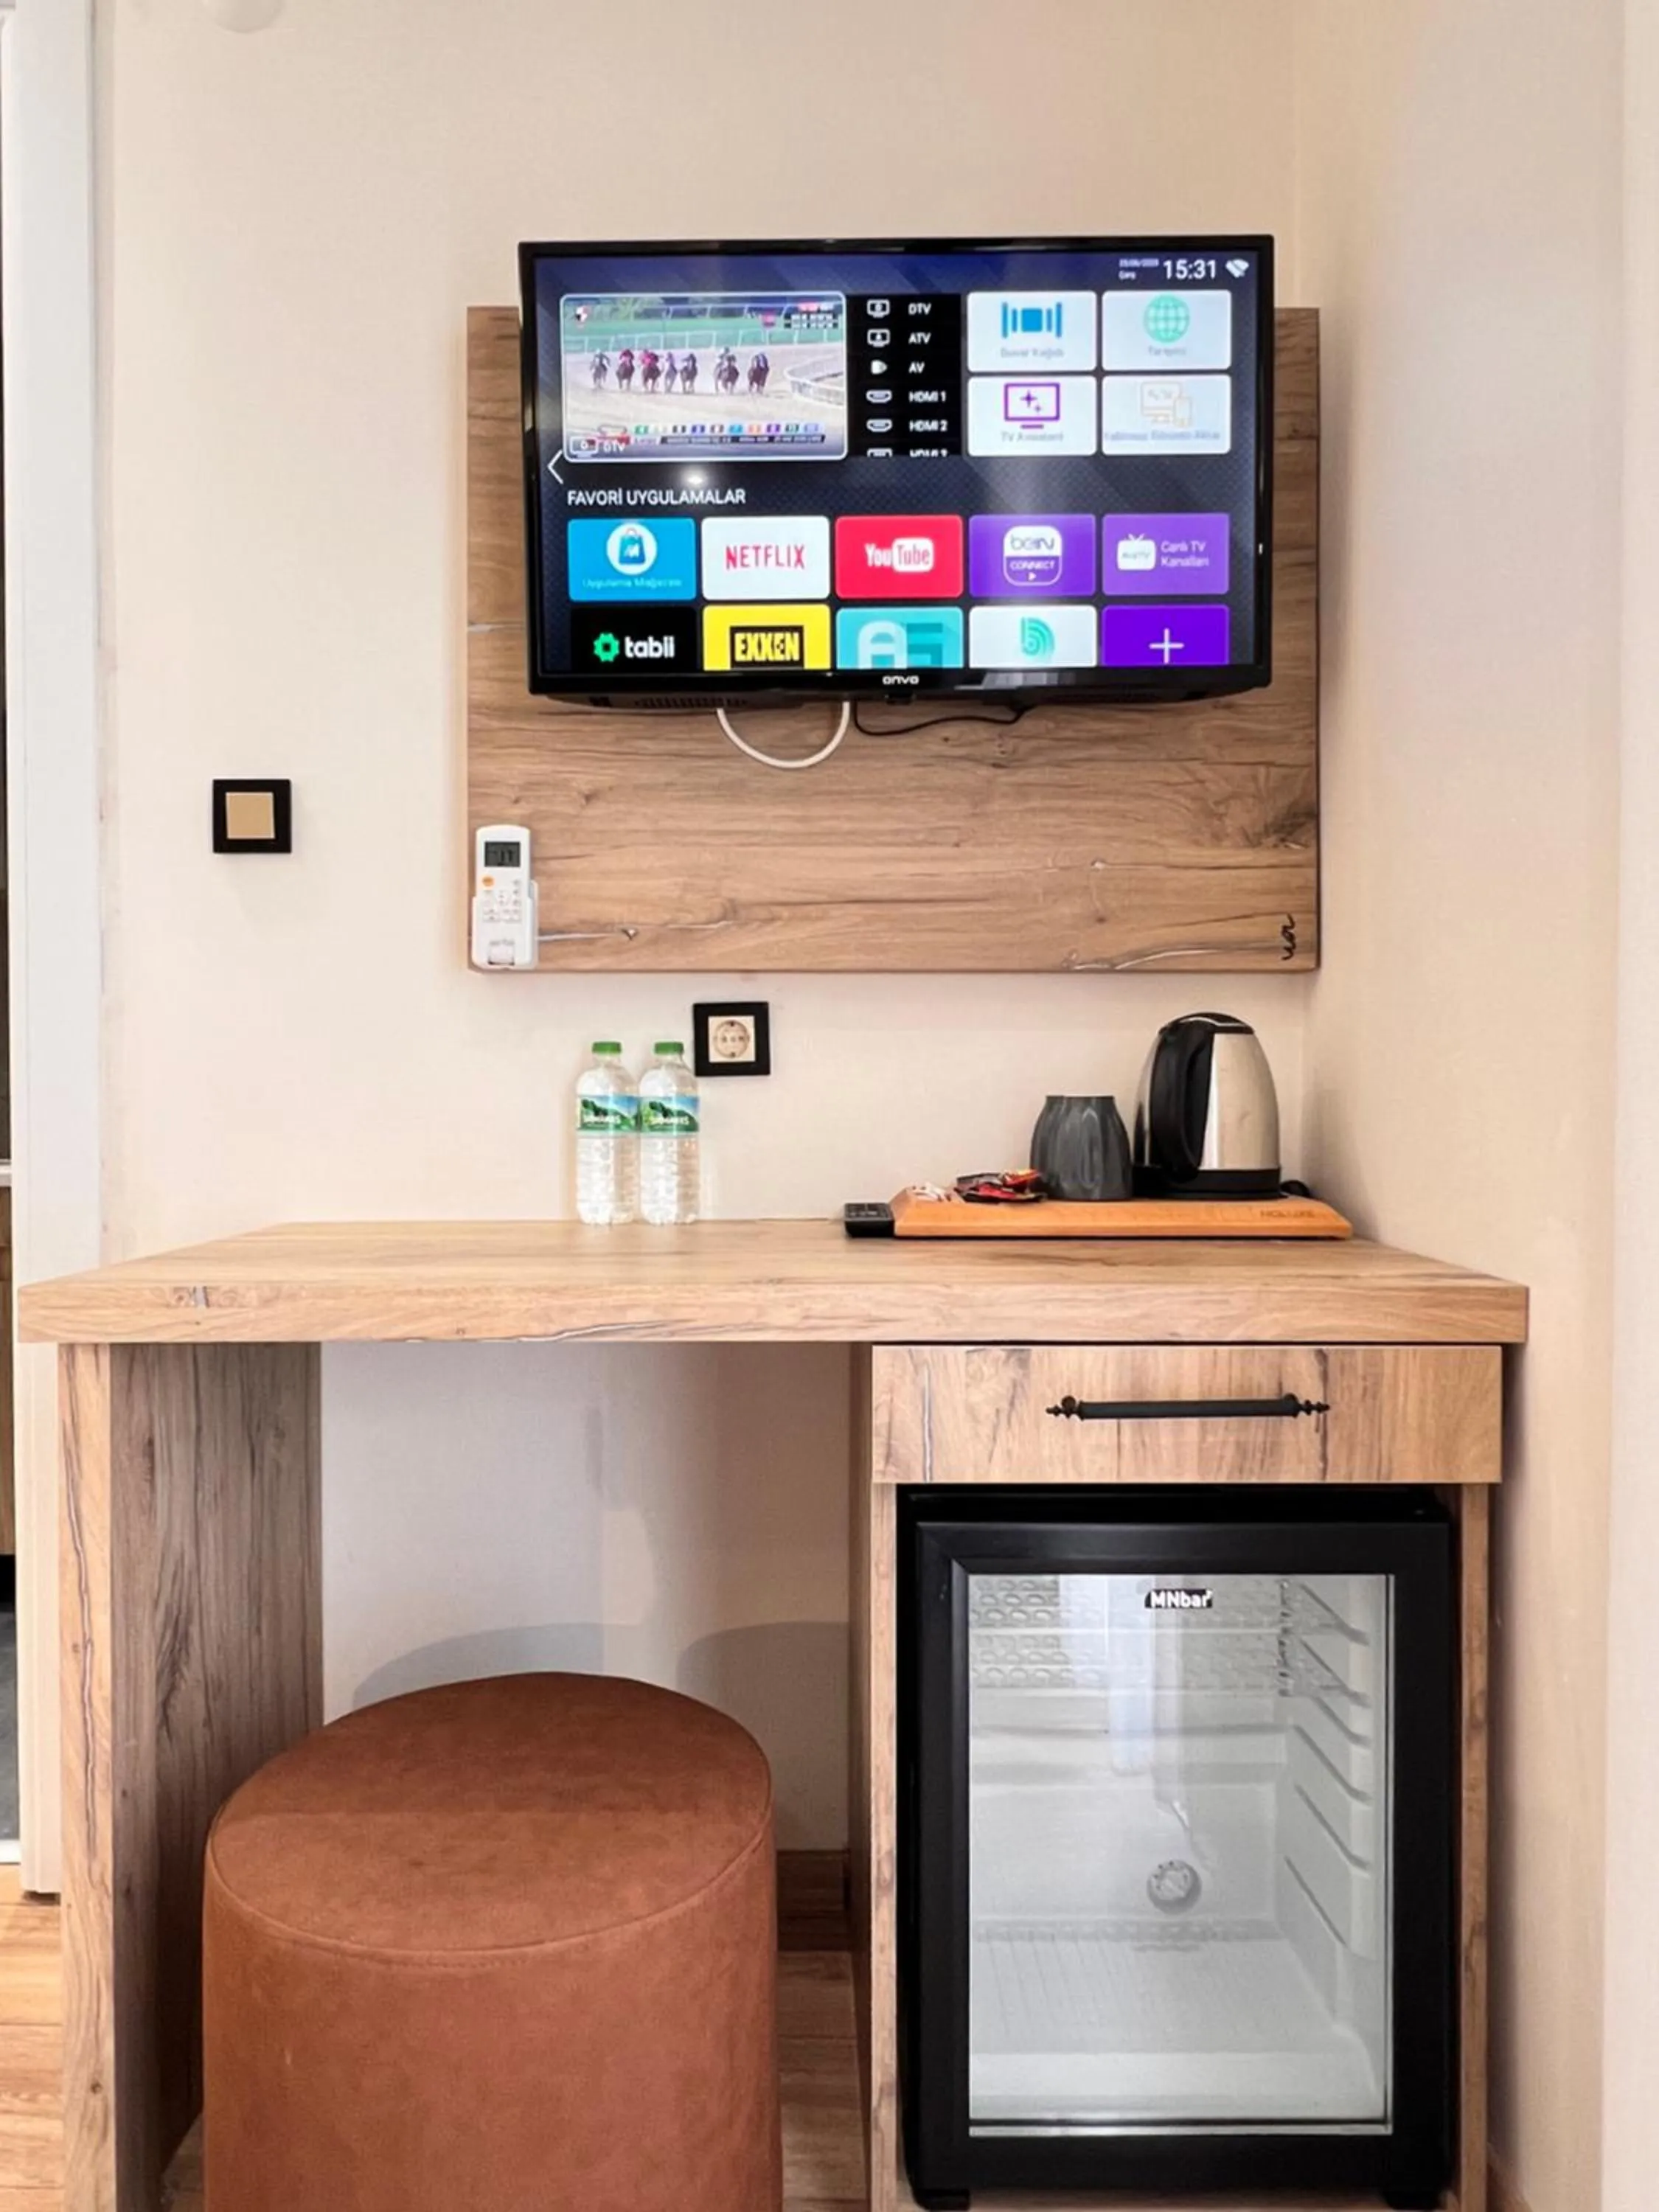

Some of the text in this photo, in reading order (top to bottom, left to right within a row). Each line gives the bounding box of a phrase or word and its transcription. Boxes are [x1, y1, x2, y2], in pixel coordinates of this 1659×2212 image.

[1163, 260, 1216, 279] 15:31
[908, 303, 931, 315] DTV
[908, 333, 931, 344] ATV
[908, 362, 925, 373] AV
[908, 391, 947, 402] HDMI 1
[909, 420, 947, 431] HDMI 2
[567, 487, 746, 506] FAVORİ UYGULAMALAR
[864, 540, 931, 568] YouTube
[1191, 540, 1206, 552] TV
[726, 544, 805, 570] NETFLIX
[625, 636, 675, 658] tabii
[734, 632, 800, 661] EXXEN
[1150, 1589, 1212, 1607] MNbar
